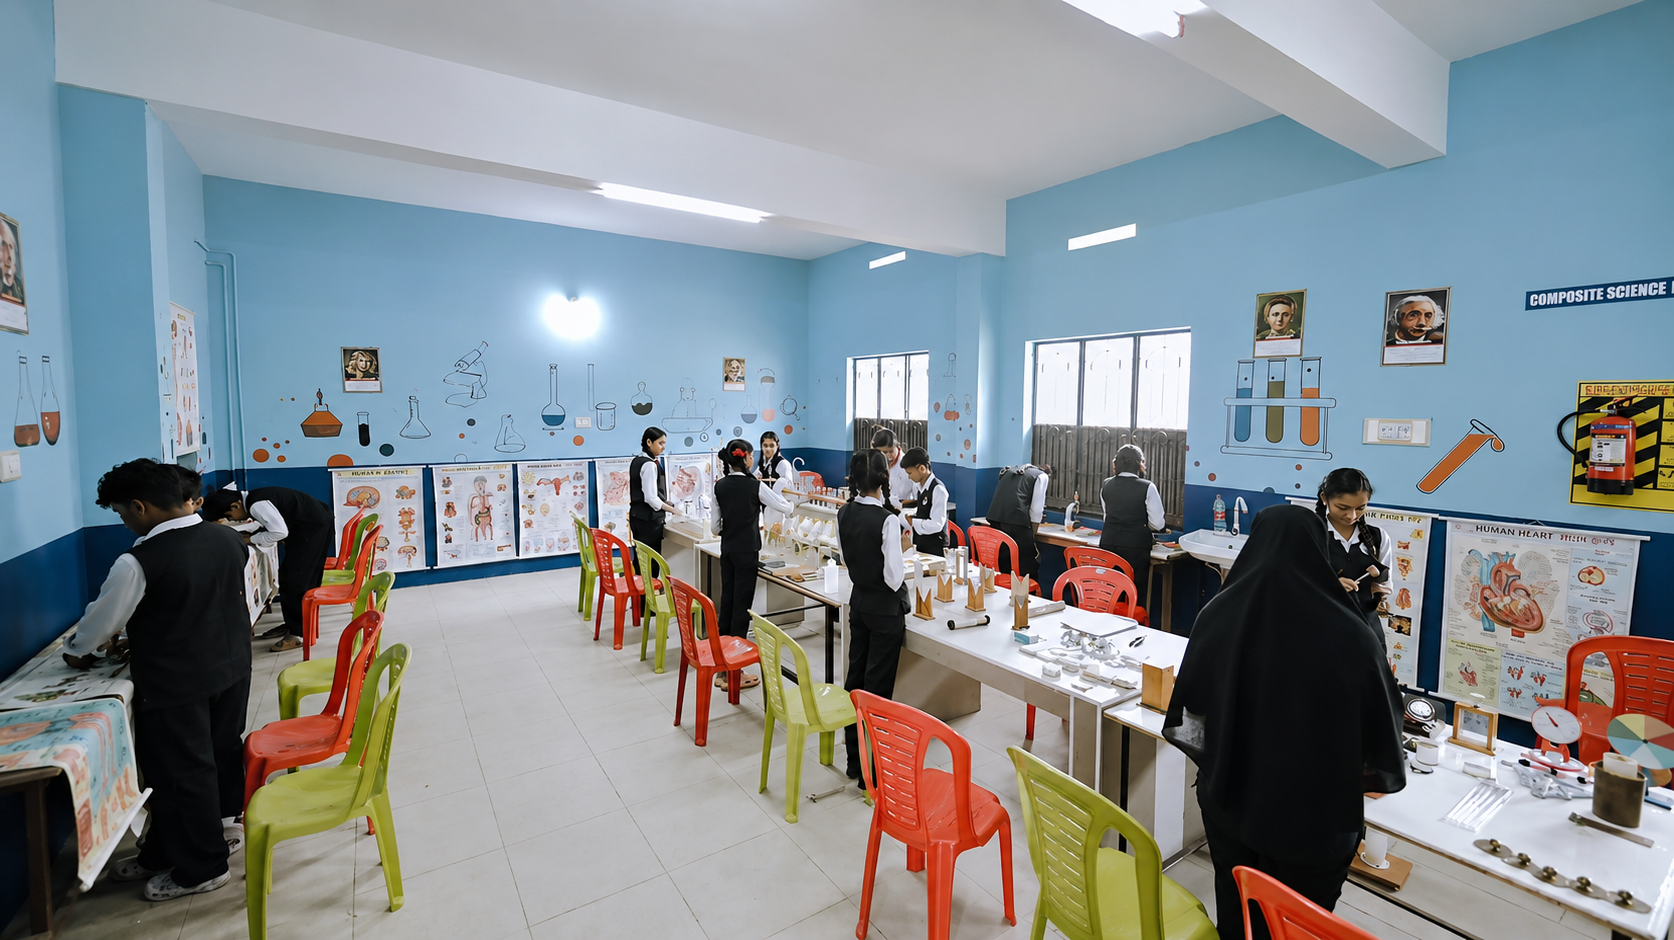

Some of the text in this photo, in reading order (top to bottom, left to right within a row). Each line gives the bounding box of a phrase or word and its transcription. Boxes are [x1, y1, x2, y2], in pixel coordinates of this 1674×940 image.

[1529, 288, 1604, 306] COMPOSITE
[1606, 281, 1667, 299] SCIENCE
[1475, 525, 1515, 536] HUMAN
